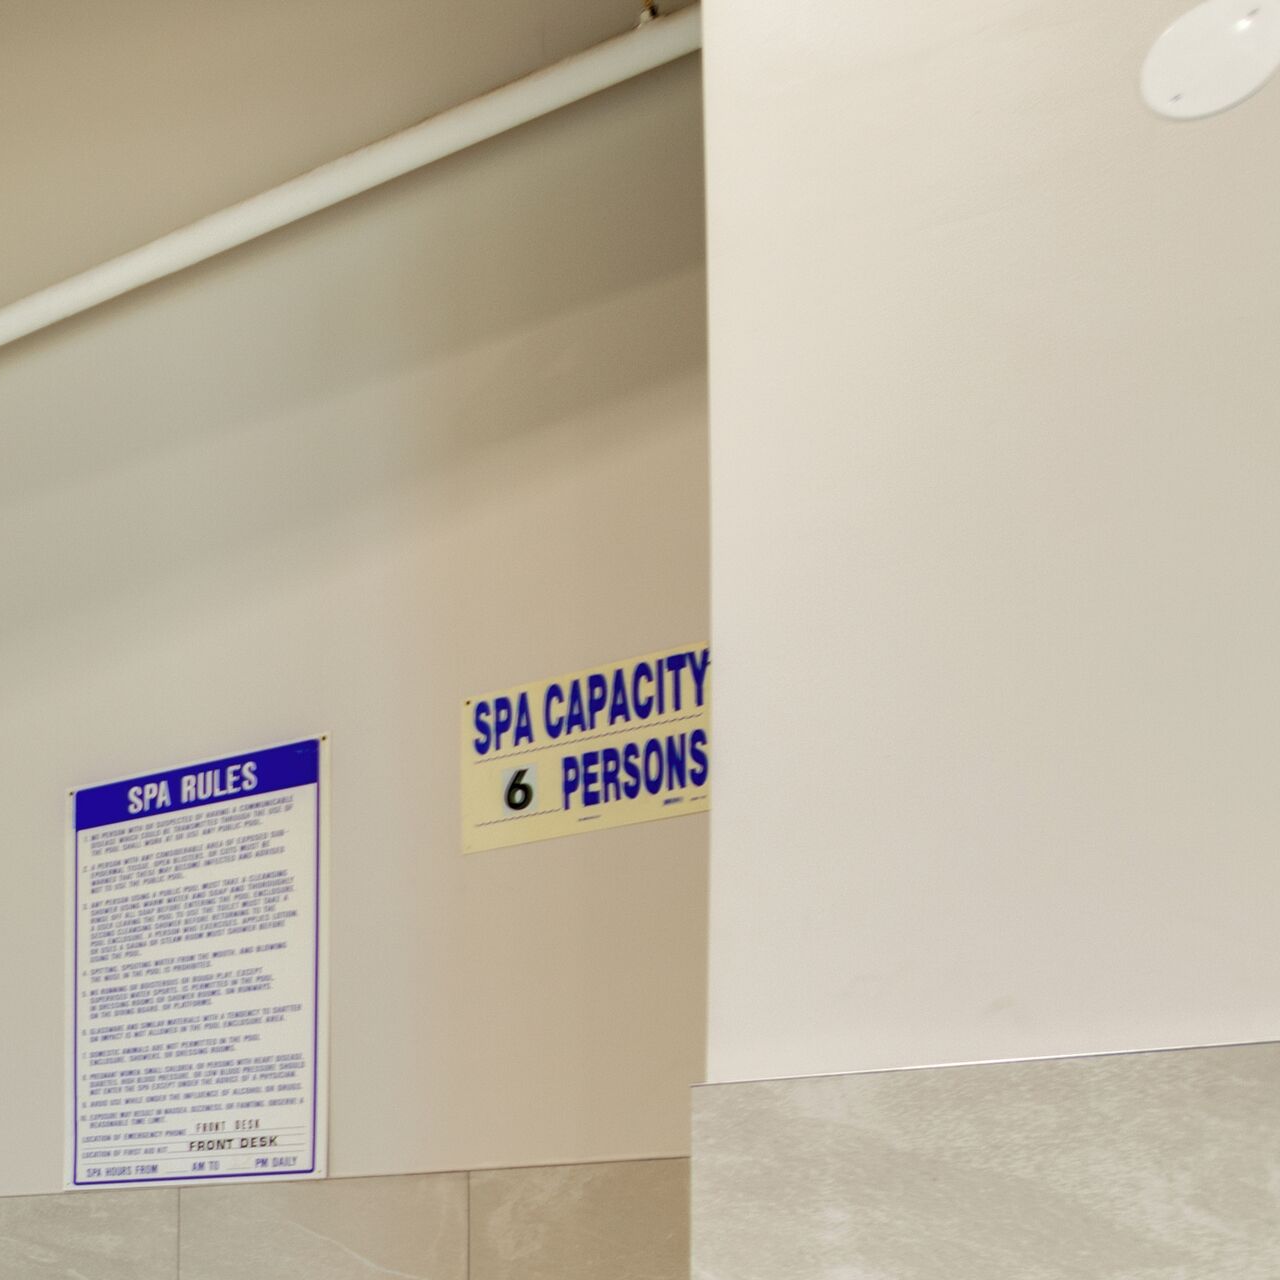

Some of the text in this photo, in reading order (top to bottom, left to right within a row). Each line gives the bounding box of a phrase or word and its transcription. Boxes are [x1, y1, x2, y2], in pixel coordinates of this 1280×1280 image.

[473, 648, 710, 755] SPA CAPACITY
[127, 760, 258, 815] SPA RULES
[505, 728, 709, 811] 6 PERSONS
[189, 1135, 278, 1152] FRONT DESK
[196, 1118, 260, 1133] FRONT DESK
[86, 1155, 298, 1178] SPA HOURS FROM AM TO PM DAILY
